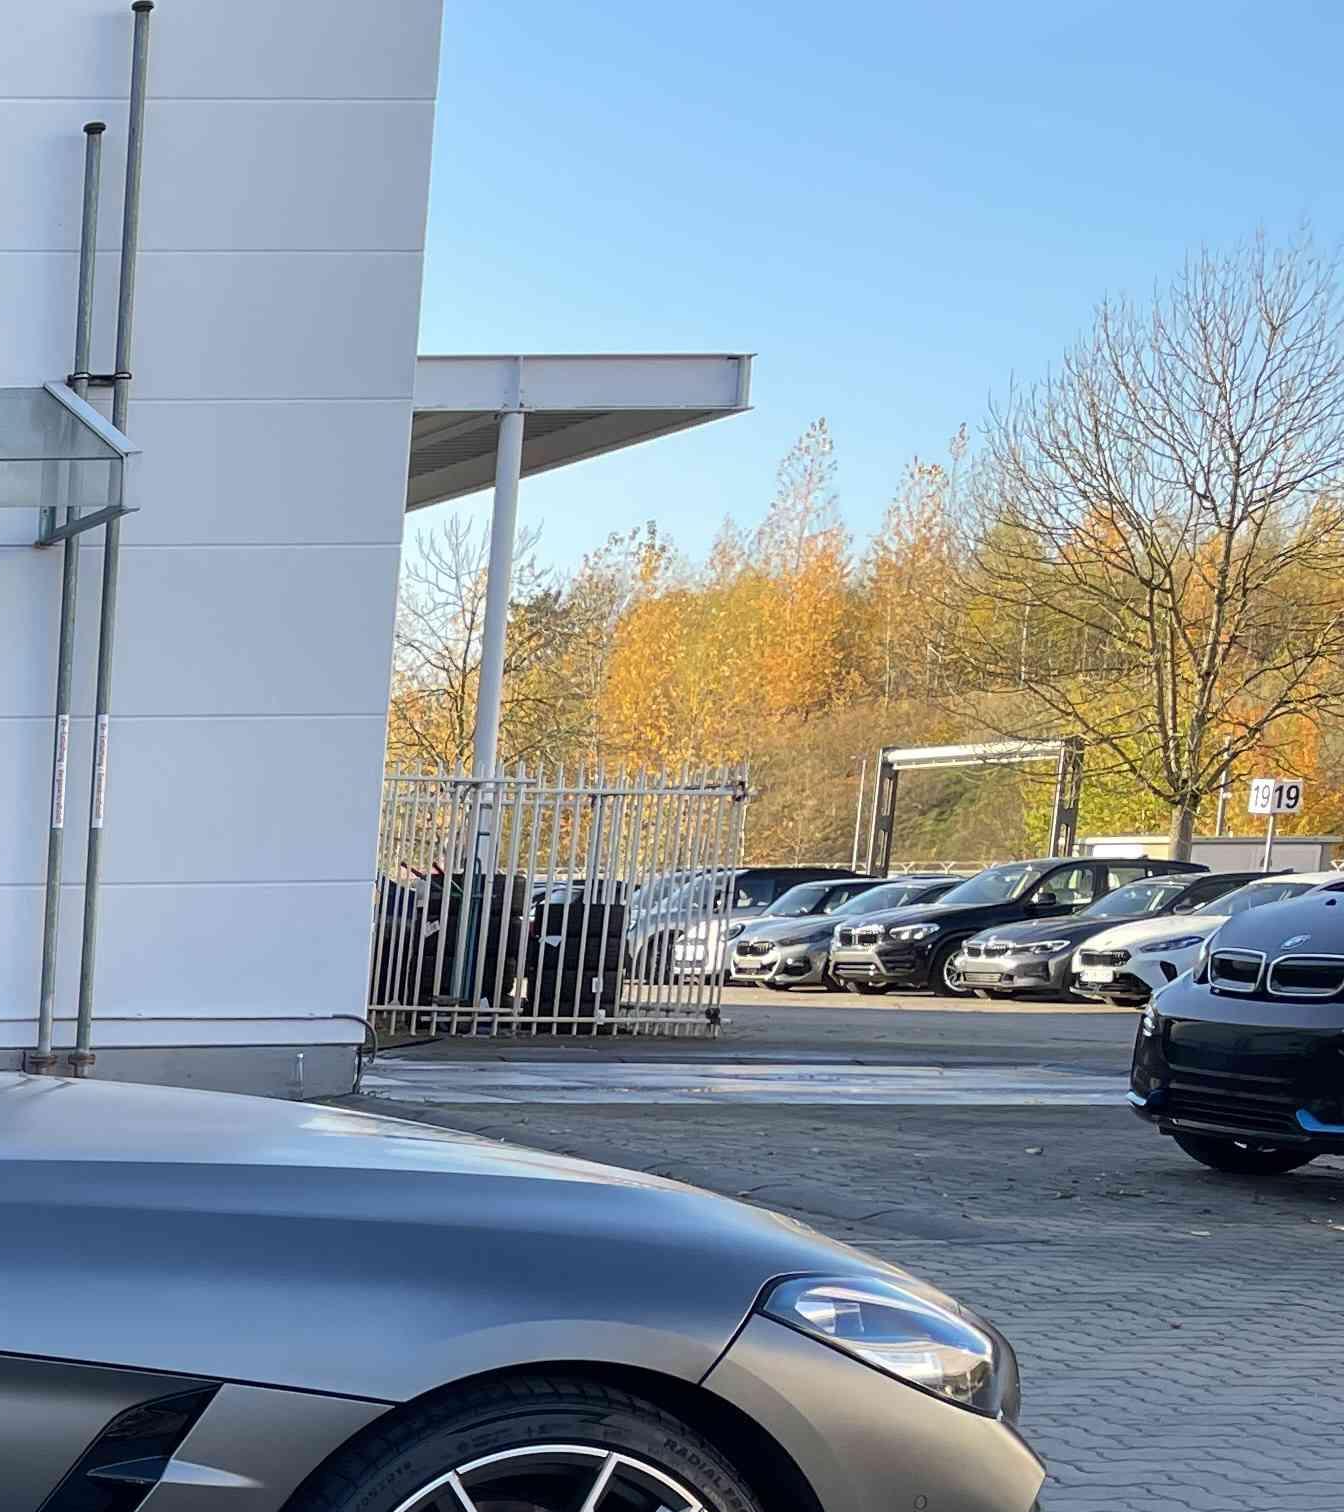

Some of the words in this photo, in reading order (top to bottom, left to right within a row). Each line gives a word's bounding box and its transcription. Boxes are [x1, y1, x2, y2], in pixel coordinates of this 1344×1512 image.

[1254, 784, 1271, 809] 19
[1274, 784, 1300, 809] 19
[663, 1438, 722, 1488] RADIAL
